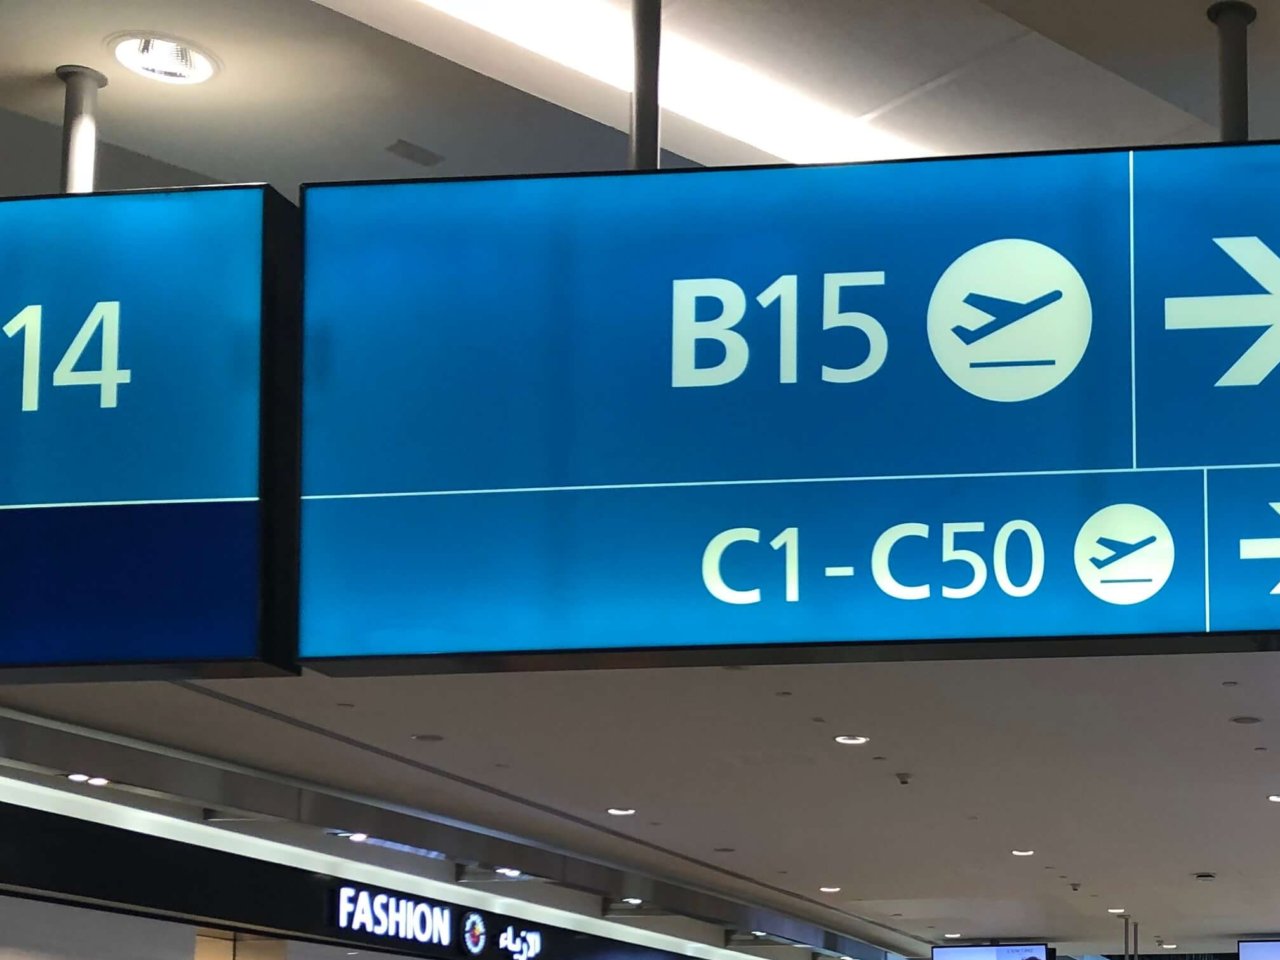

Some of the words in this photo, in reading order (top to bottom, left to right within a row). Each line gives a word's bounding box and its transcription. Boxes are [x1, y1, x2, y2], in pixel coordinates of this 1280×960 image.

[2, 301, 132, 411] 14
[671, 271, 889, 388] B15
[338, 886, 451, 947] FASHION
